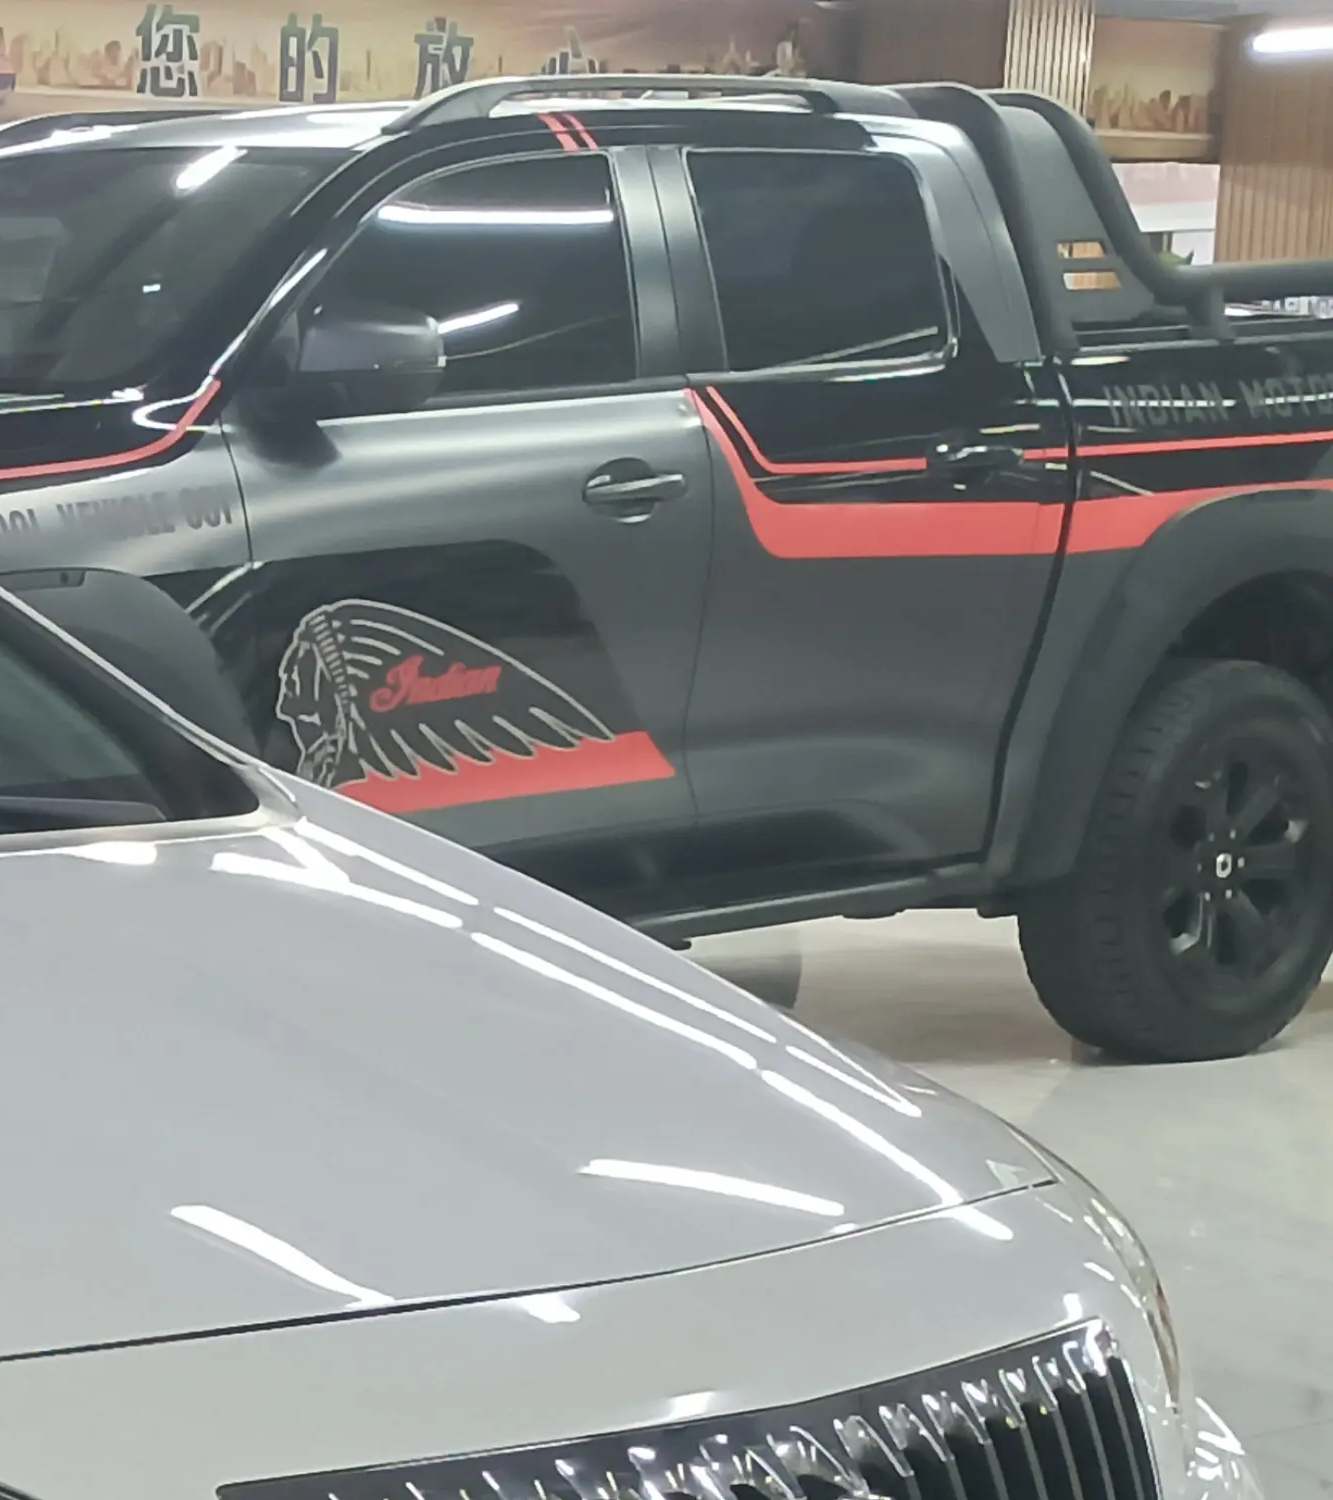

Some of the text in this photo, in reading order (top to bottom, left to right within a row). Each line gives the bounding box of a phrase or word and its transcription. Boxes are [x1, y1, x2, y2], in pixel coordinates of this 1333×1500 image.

[1102, 372, 1333, 428] INDIAN MOTO
[370, 654, 502, 712] Indian
